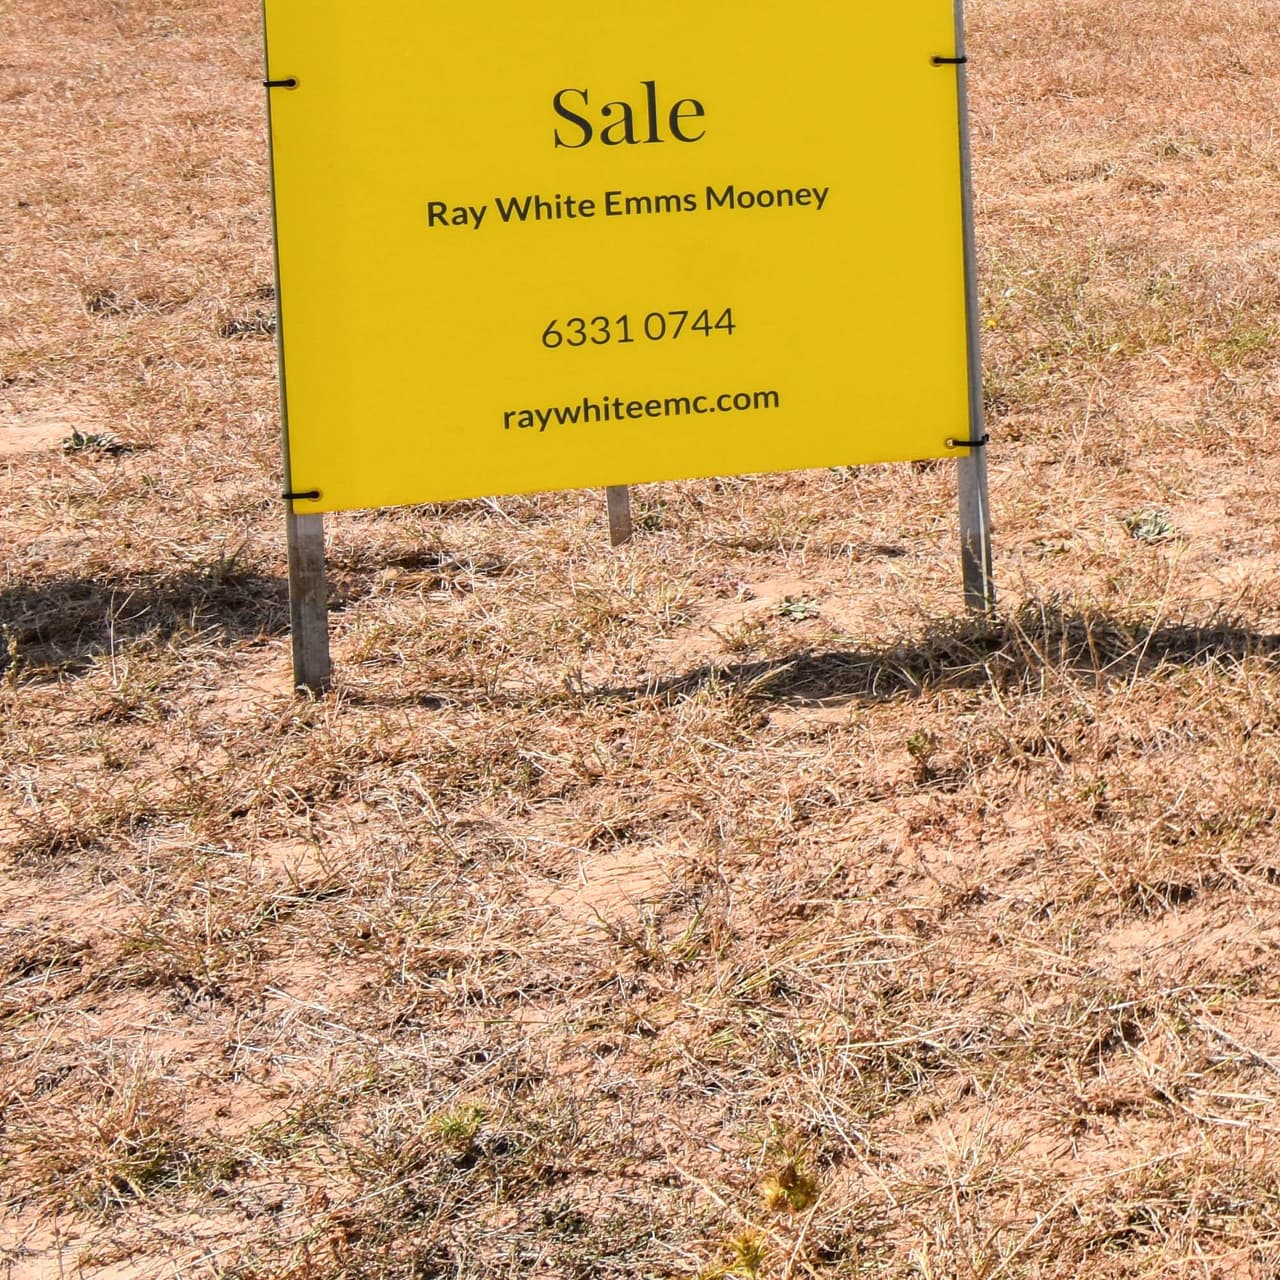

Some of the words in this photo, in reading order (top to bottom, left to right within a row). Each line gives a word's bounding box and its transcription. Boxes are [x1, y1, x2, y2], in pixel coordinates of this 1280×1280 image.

[552, 79, 707, 149] Sale
[426, 201, 488, 231] Ray
[494, 193, 597, 224] White
[604, 190, 698, 217] Emms
[705, 184, 830, 212] Mooney
[541, 313, 635, 350] 6331
[643, 307, 737, 342] 0744
[503, 389, 780, 433] raywhiteemc.com
